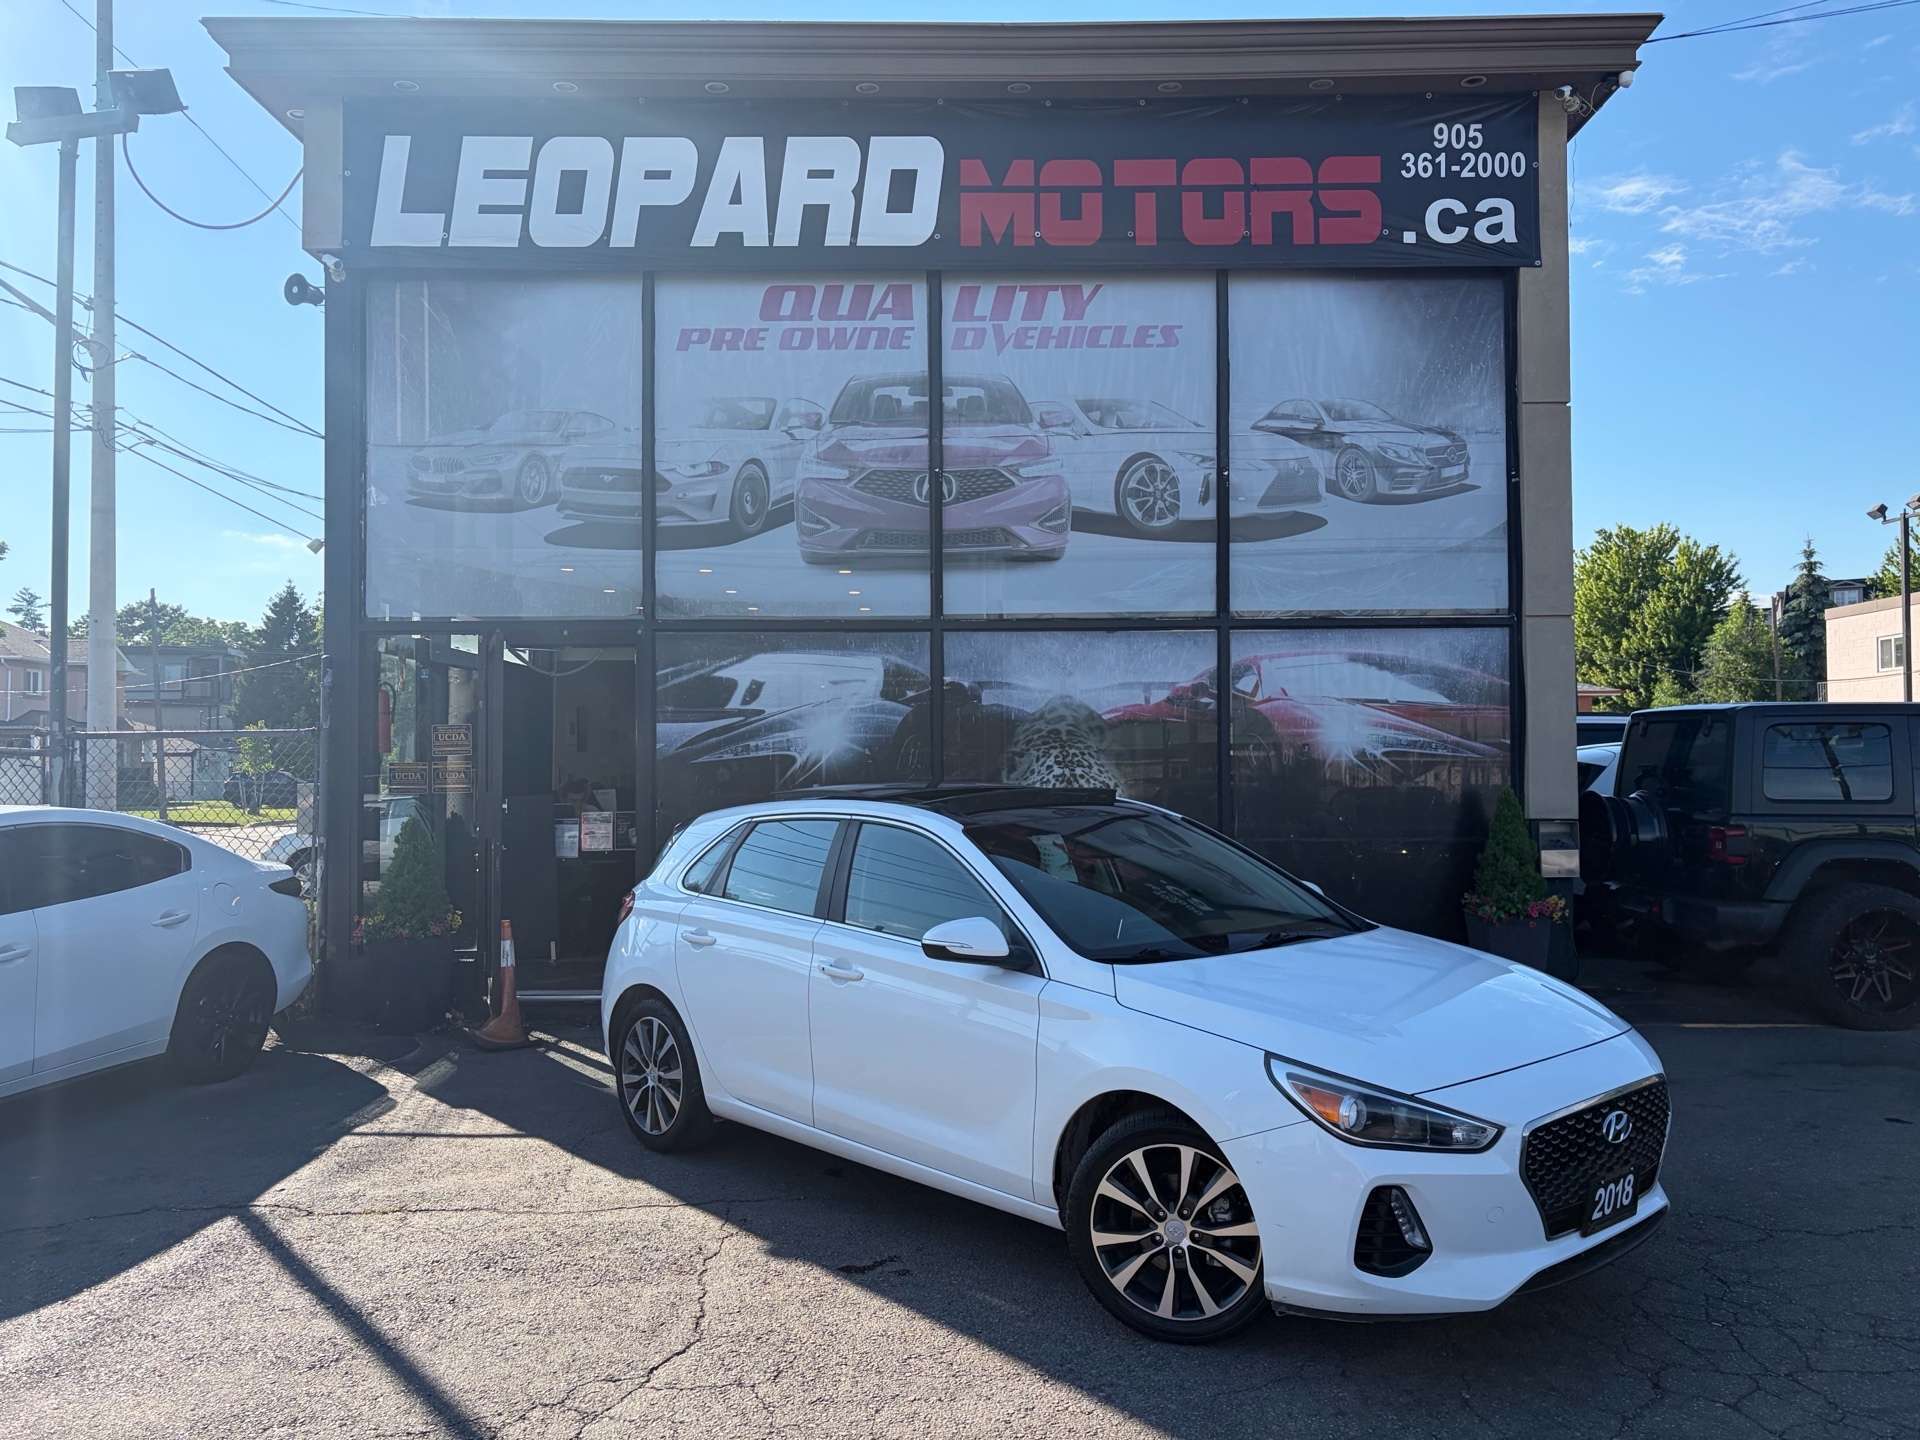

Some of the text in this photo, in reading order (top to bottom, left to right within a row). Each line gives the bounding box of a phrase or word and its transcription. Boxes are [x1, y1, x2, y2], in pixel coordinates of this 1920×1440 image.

[1433, 122, 1484, 149] 905
[1400, 151, 1527, 179] 361-2000
[370, 134, 1383, 248] LEOPARD MOTORS
[1403, 197, 1519, 244] .ca
[676, 327, 770, 352] PRE
[1591, 1173, 1635, 1221] 2018
